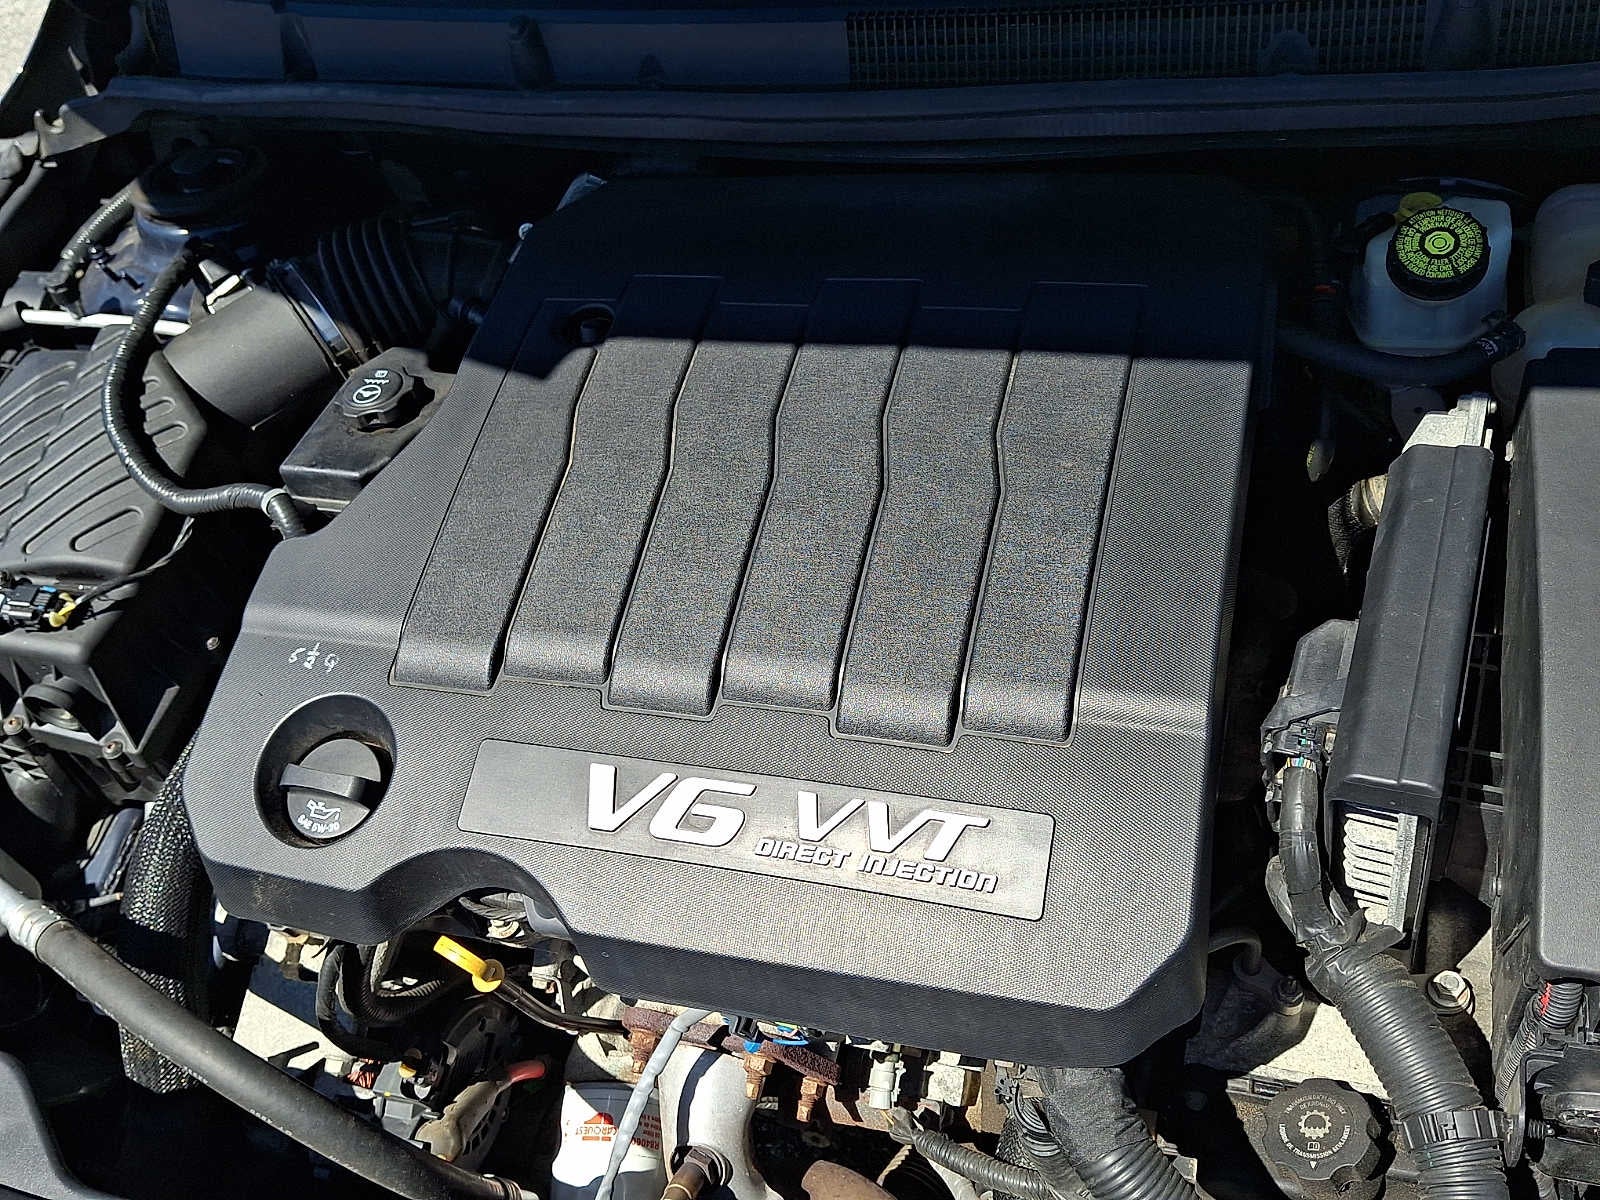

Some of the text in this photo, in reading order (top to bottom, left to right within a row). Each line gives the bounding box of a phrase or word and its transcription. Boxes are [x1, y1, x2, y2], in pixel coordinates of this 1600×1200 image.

[588, 763, 991, 862] V6 VVT
[754, 838, 999, 894] DIRECT INJECTION
